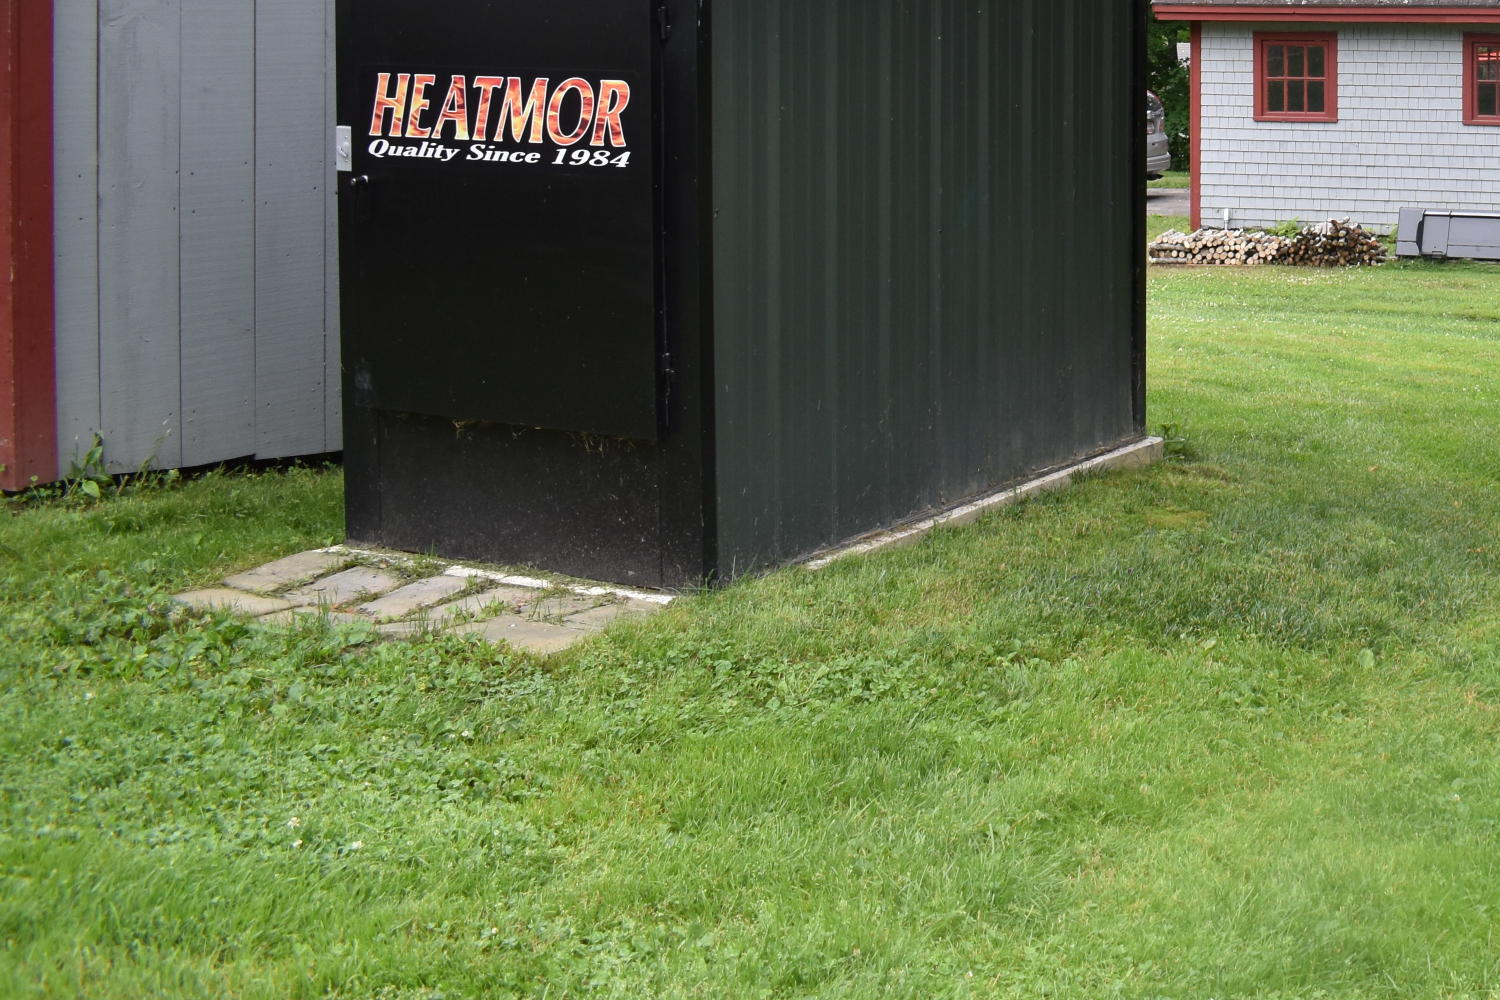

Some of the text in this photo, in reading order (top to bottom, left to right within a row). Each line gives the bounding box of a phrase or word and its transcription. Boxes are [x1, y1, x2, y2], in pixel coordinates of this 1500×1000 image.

[368, 72, 631, 148] HEATMOR
[368, 138, 631, 168] Quality Since 1984
